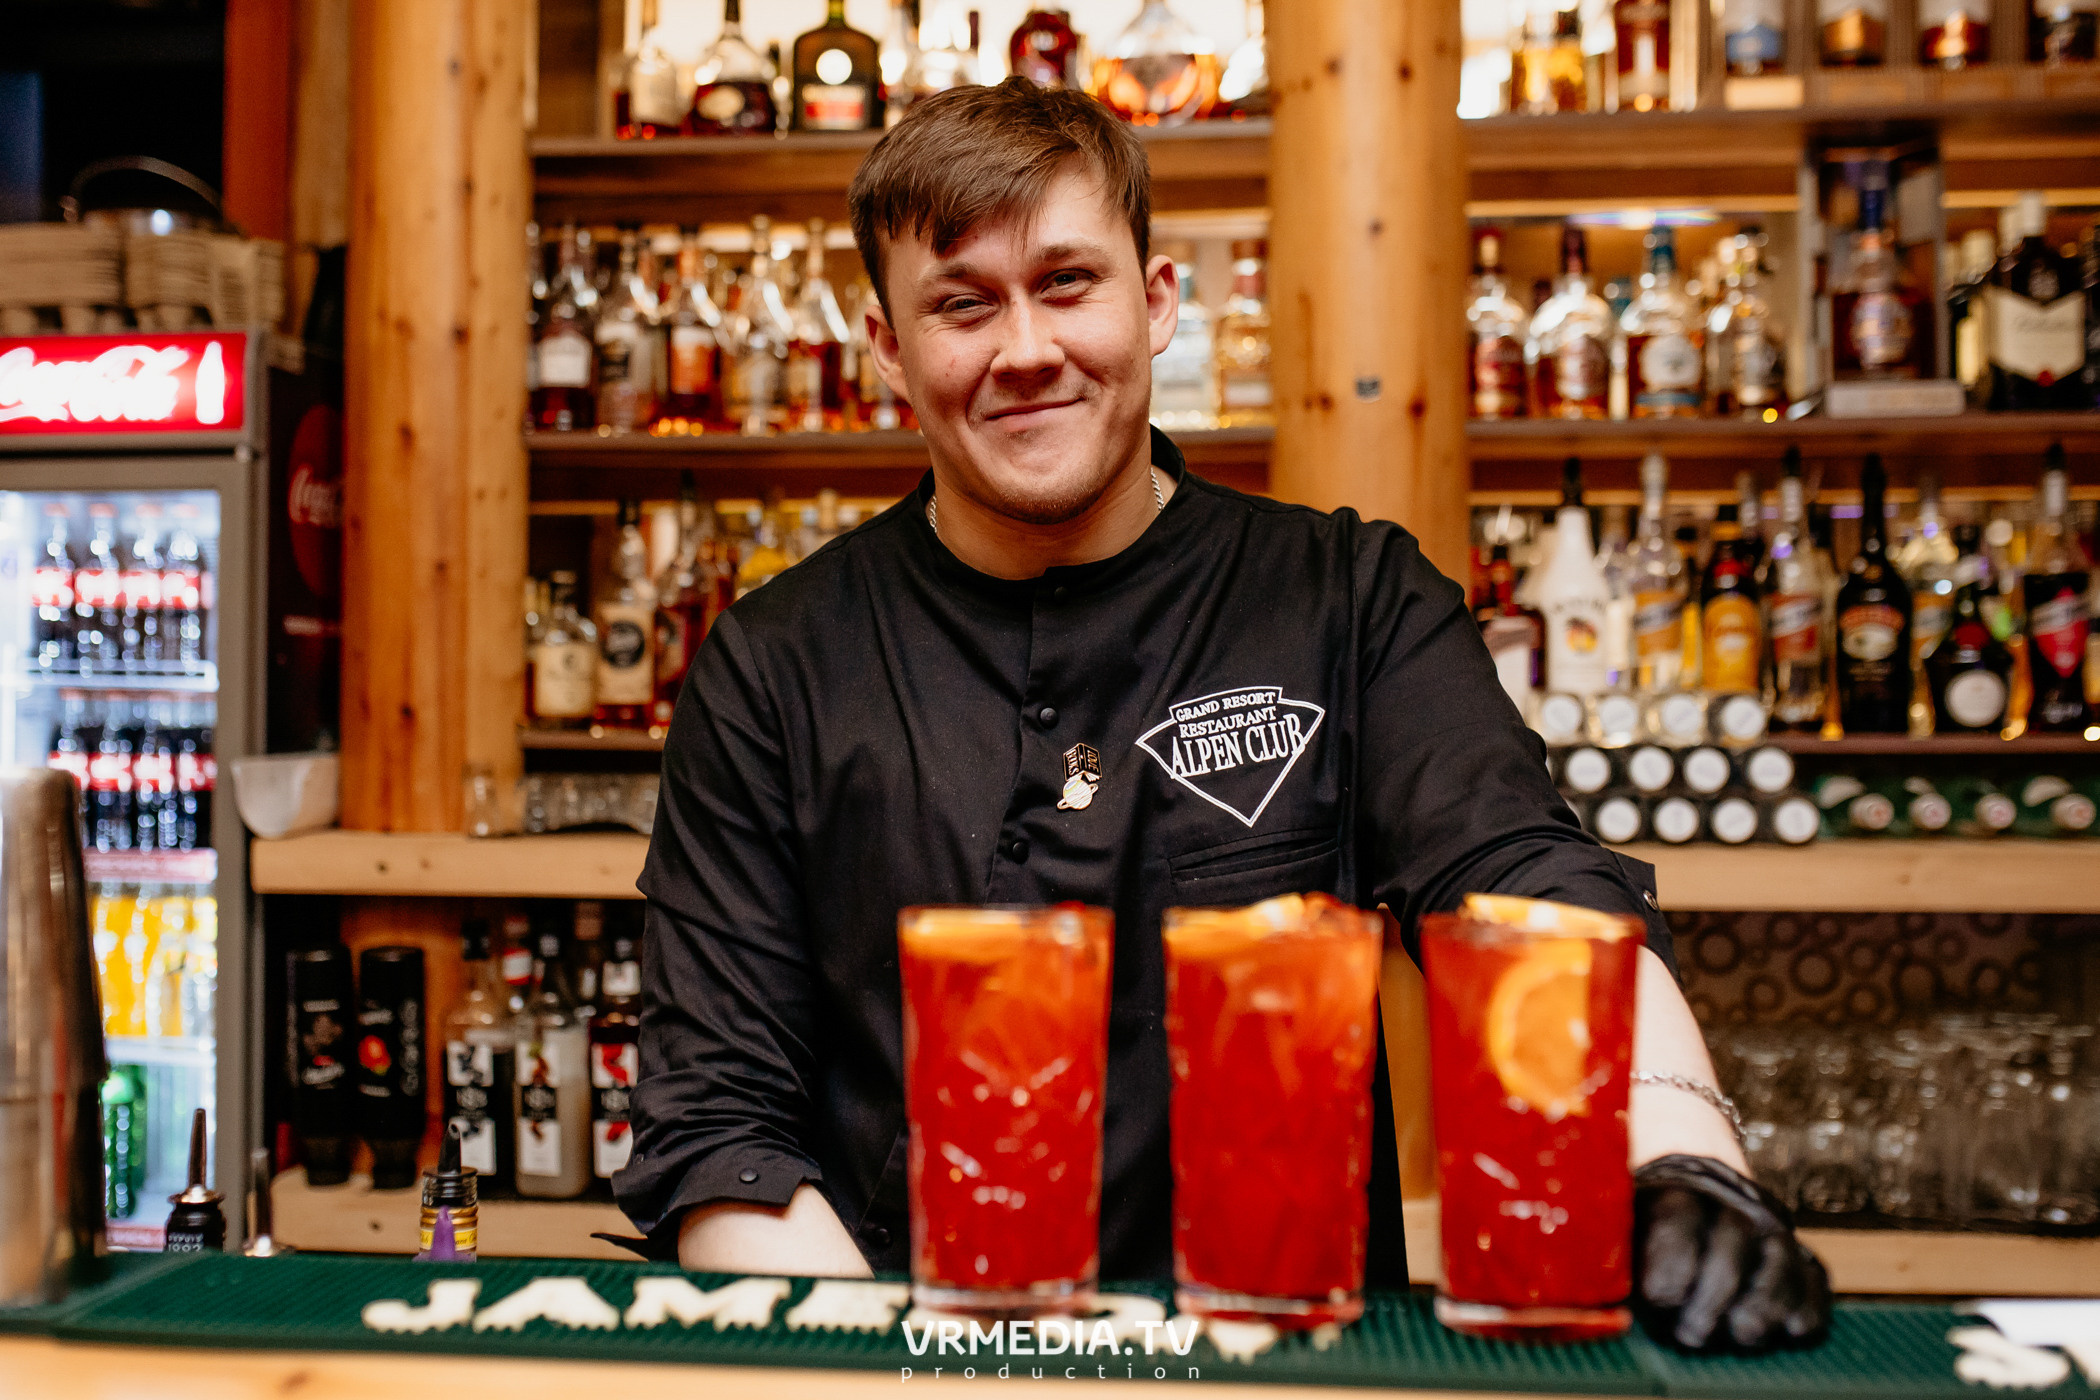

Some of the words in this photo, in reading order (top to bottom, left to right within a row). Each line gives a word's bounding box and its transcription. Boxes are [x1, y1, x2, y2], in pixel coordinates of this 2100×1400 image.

[1175, 699, 1220, 723] GRAND
[1223, 692, 1276, 710] RESORT
[1178, 706, 1277, 739] RESTAURANT
[1171, 730, 1244, 779] ALPEN
[1245, 713, 1306, 763] CLUB
